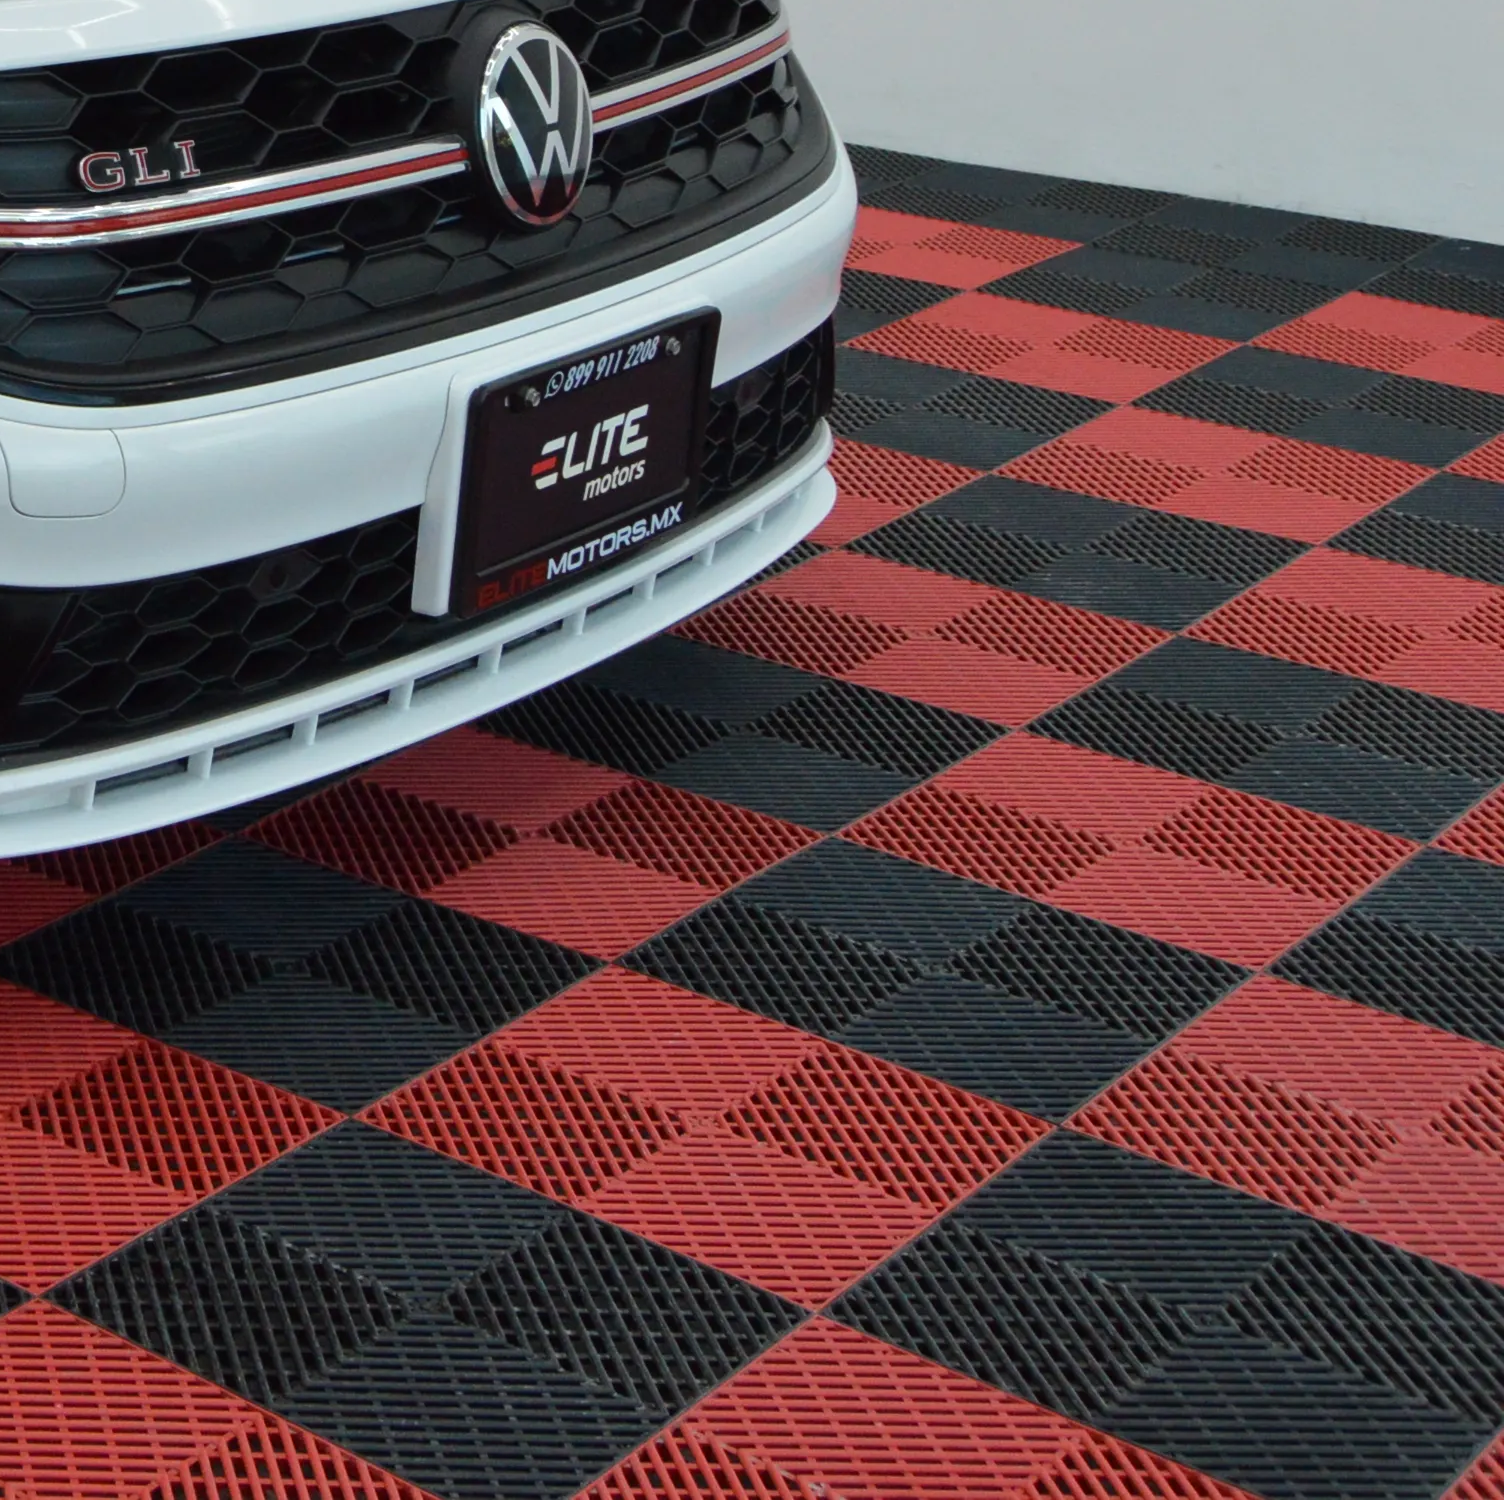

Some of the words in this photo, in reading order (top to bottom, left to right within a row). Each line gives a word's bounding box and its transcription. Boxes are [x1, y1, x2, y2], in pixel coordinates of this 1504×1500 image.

[78, 139, 202, 193] GLI
[563, 359, 595, 392] 899
[595, 349, 623, 381] 911
[622, 334, 661, 370] 2208
[530, 403, 650, 491] ELITE
[582, 459, 646, 502] motors
[477, 501, 684, 609] ELITEMOTORS.MX
